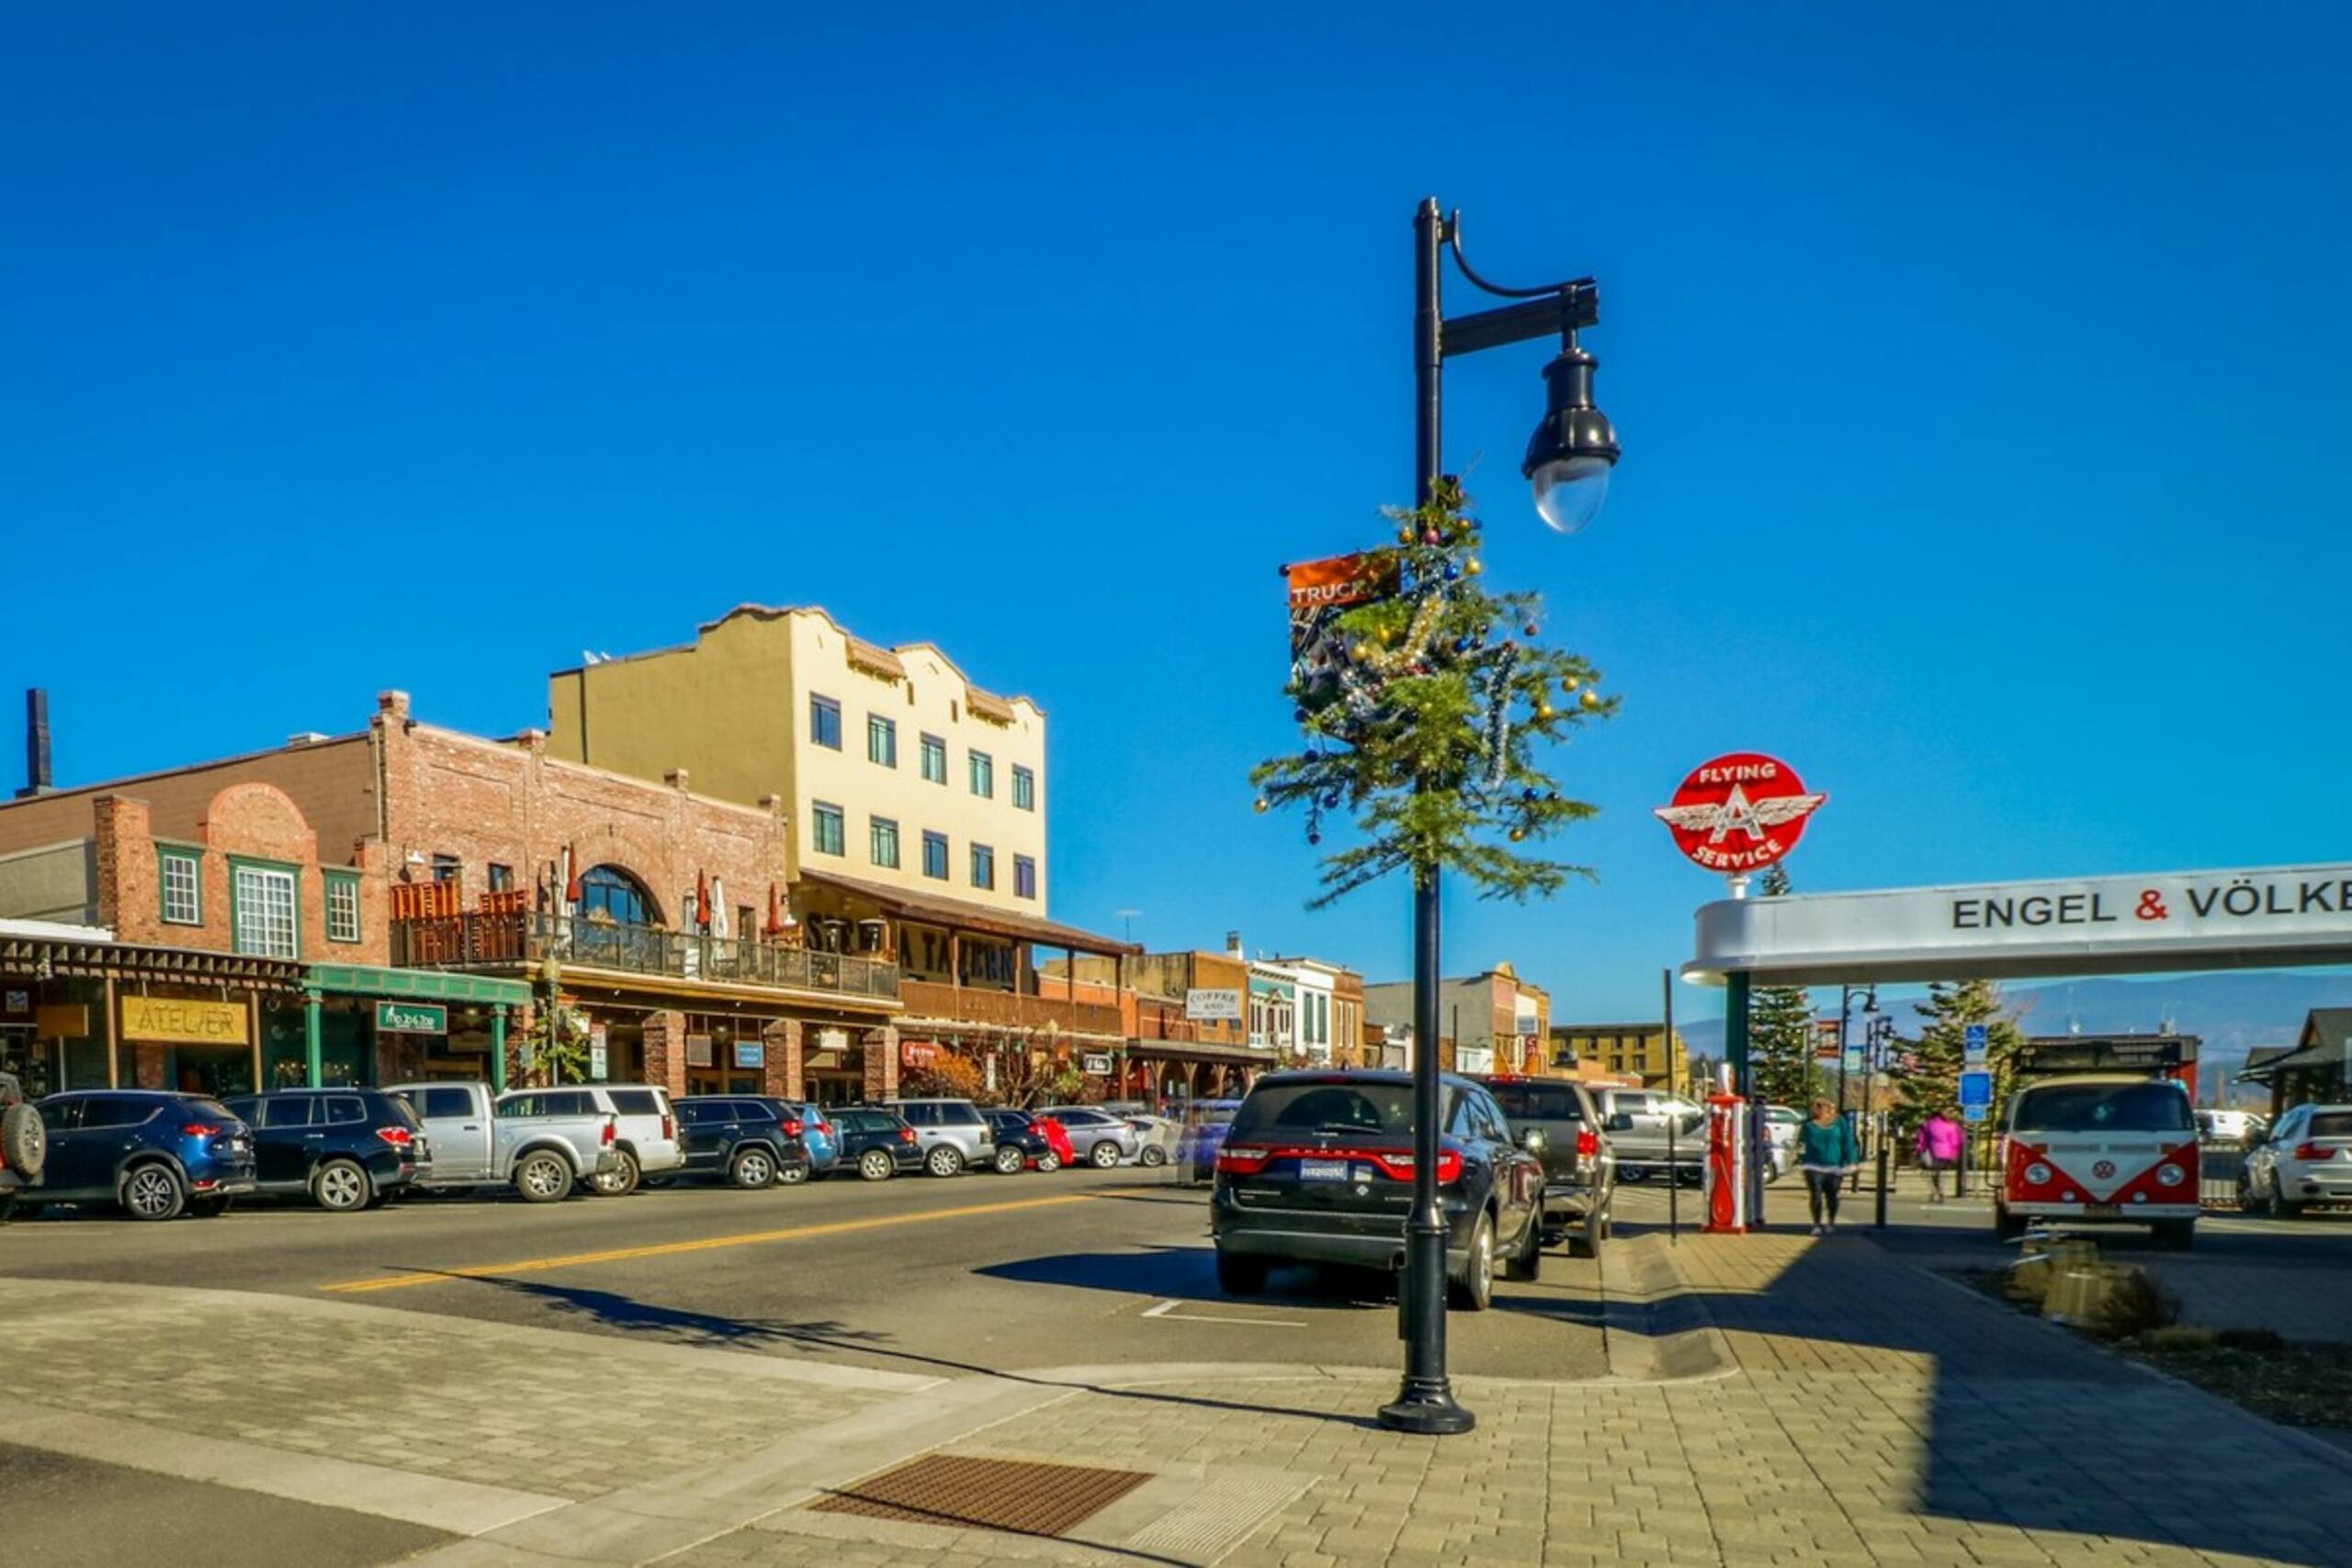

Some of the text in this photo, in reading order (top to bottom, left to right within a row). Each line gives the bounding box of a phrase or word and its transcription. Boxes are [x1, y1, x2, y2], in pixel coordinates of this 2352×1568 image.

[1699, 762, 1777, 784] FLYING
[1691, 839, 1783, 867] SERVICE
[1952, 893, 2118, 929] ENGEL
[2134, 888, 2169, 922] &
[138, 1005, 235, 1035] ATELIER
